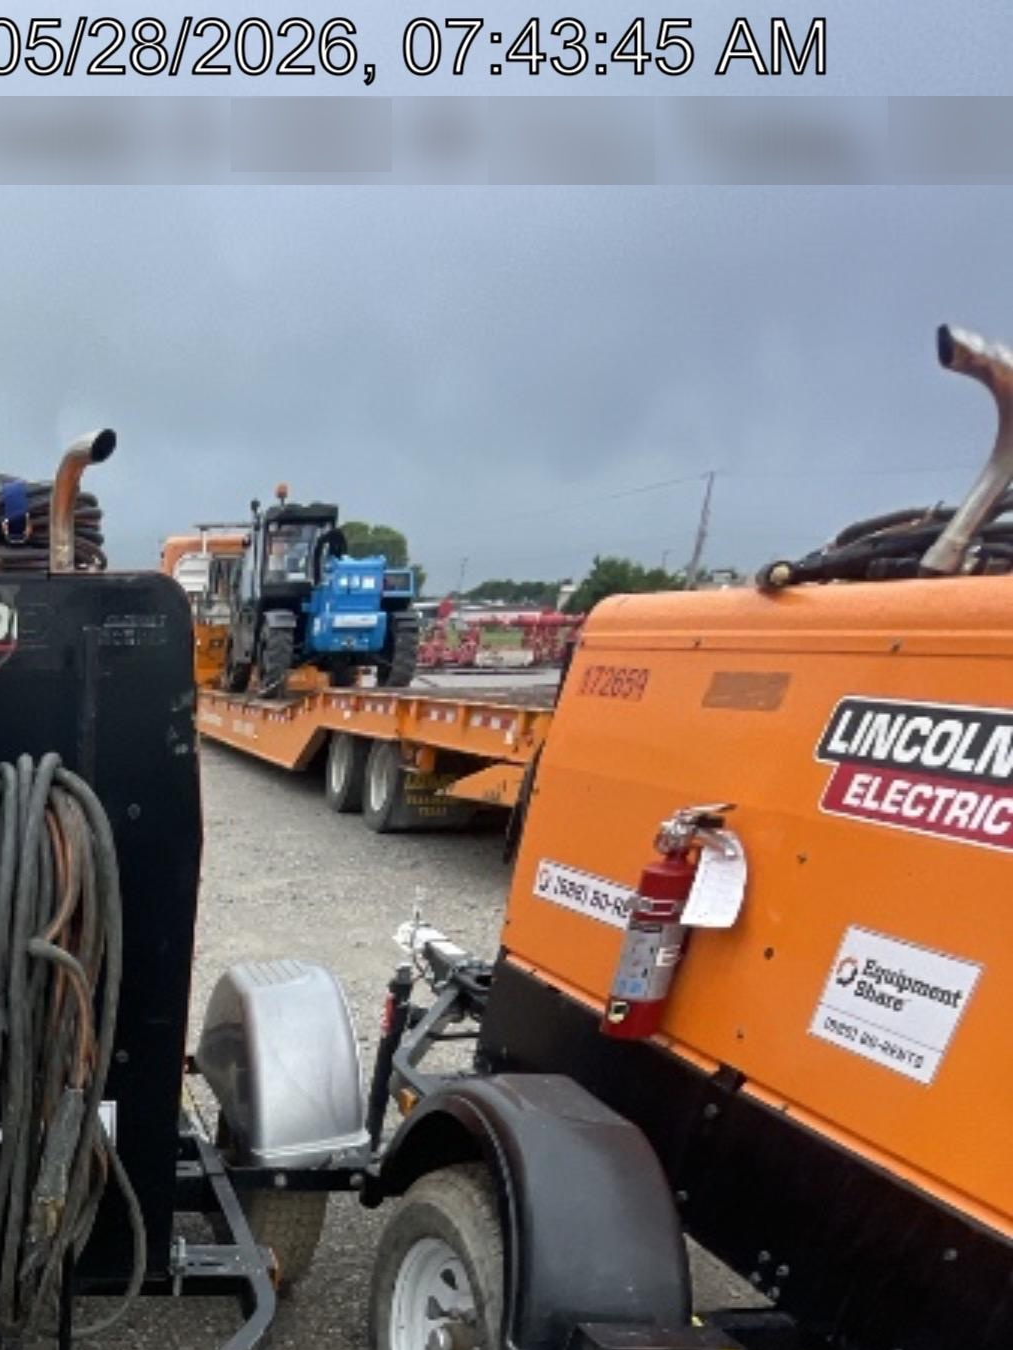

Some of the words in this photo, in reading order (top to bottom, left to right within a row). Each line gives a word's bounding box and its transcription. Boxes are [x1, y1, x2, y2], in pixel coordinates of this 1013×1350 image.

[826, 709, 1013, 779] LINCOLN
[841, 772, 1013, 836] ELECTRIC
[853, 979, 905, 1012] Share
[861, 957, 963, 1010] Equipment
